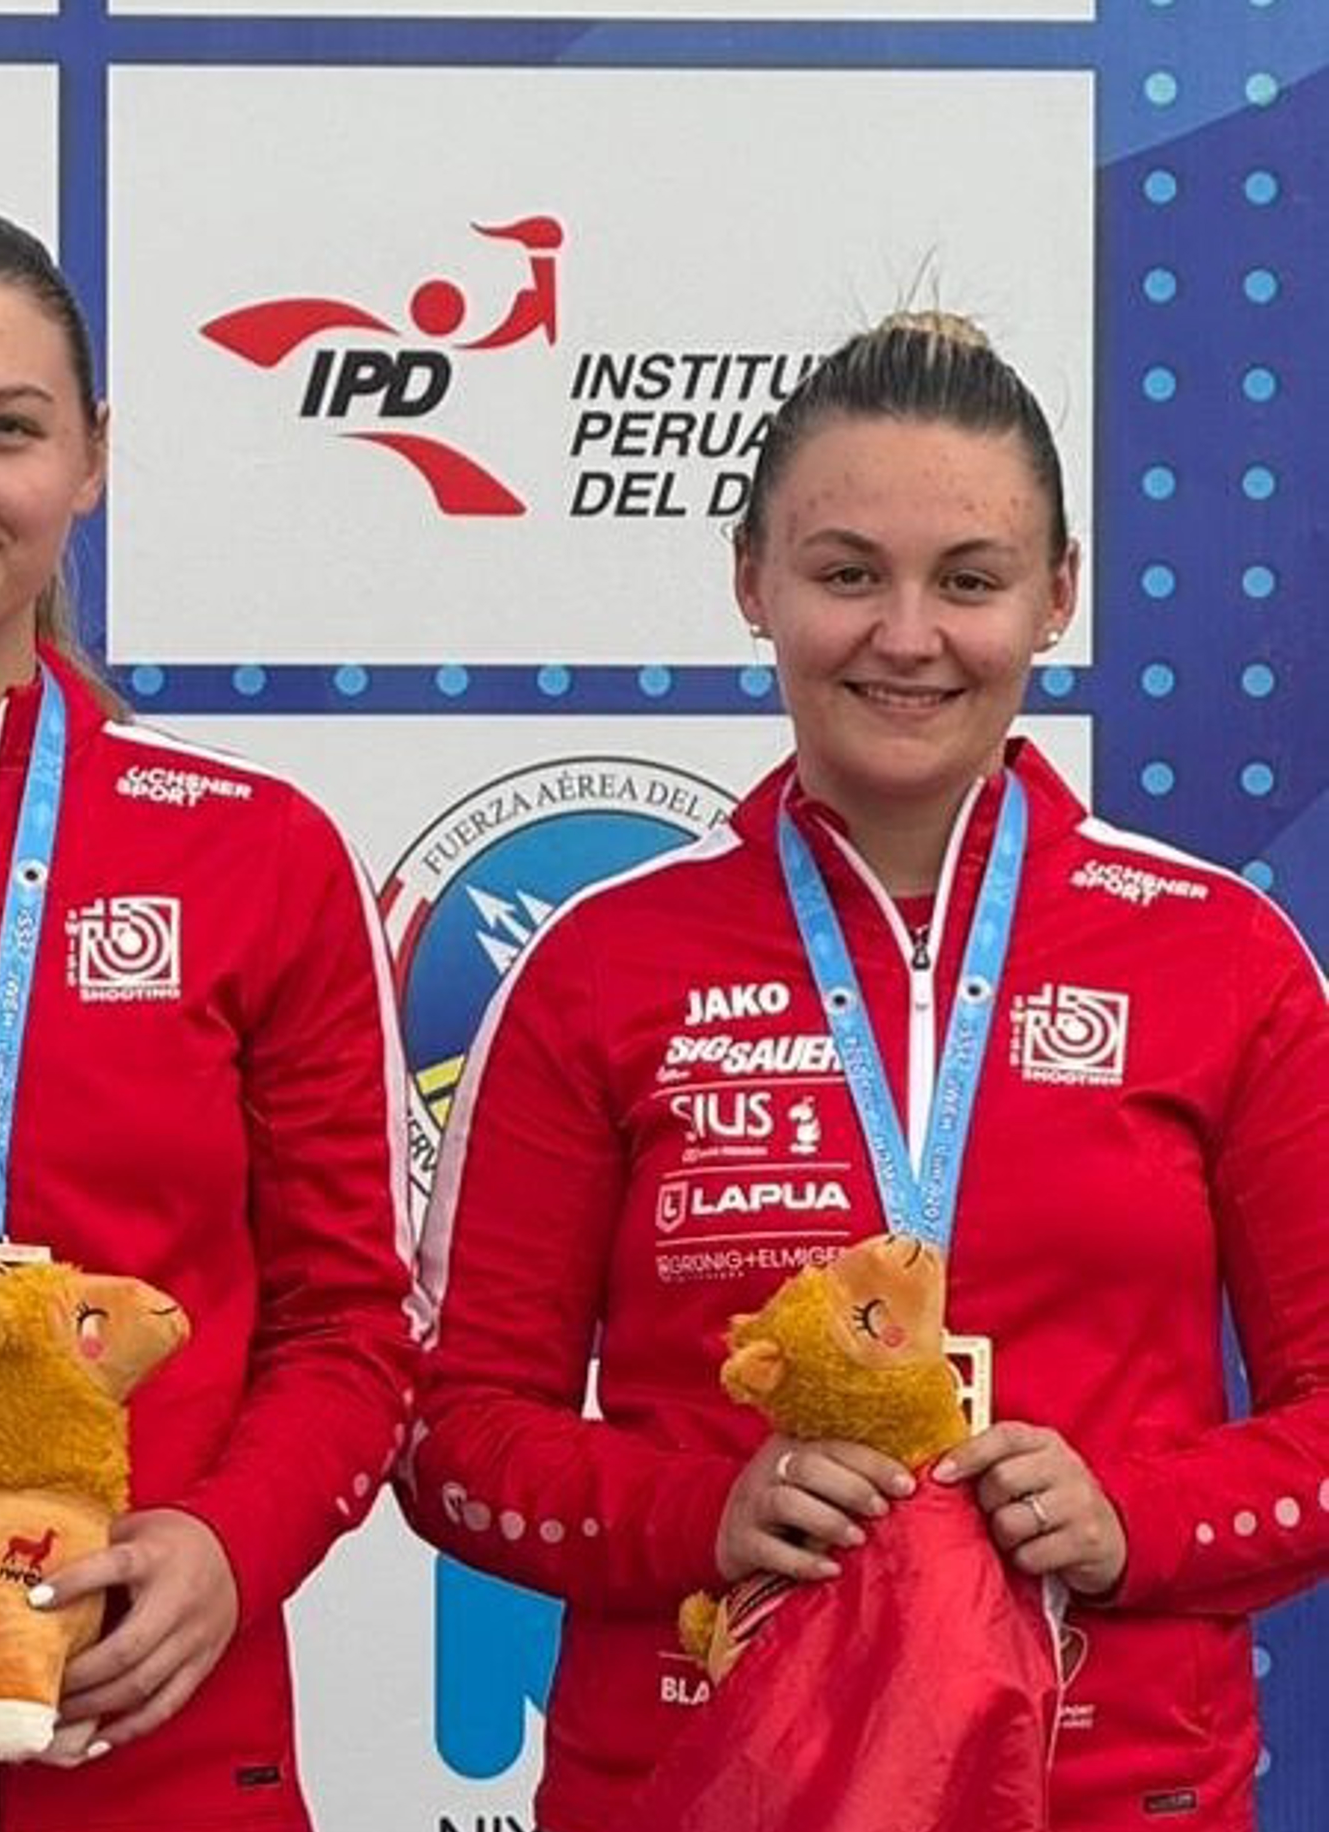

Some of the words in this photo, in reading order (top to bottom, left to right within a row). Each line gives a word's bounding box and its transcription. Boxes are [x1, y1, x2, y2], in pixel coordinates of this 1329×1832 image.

[299, 350, 453, 417] IPD
[571, 354, 824, 400] INSTITU
[570, 472, 688, 517] DEL
[421, 790, 533, 876] FUERZA
[535, 770, 639, 807] AÉREA
[645, 779, 702, 822] DEL
[684, 982, 791, 1026] JAKO
[670, 1091, 773, 1142] SIUS
[690, 1181, 852, 1216] LAPUA
